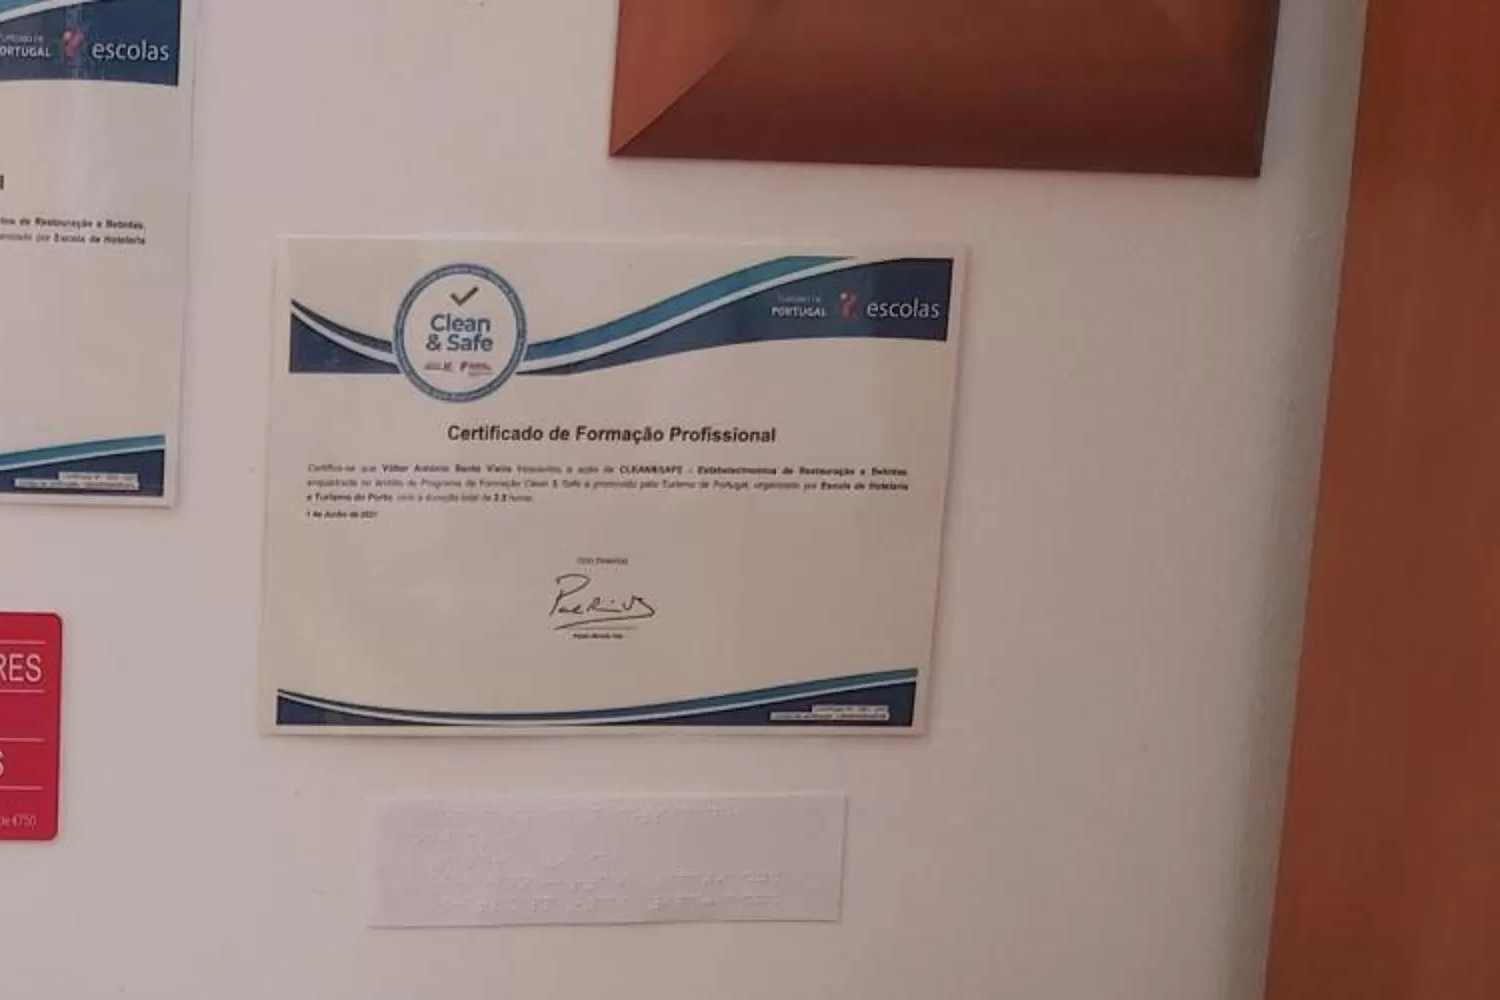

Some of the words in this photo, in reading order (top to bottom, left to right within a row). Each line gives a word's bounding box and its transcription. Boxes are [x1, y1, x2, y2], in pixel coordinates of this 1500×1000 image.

[92, 40, 170, 62] escolas
[771, 306, 827, 318] PORTUGAL
[866, 297, 941, 320] escolas
[430, 313, 491, 333] Clean
[425, 334, 442, 352] &
[447, 333, 494, 352] Safe
[447, 424, 544, 442] Certificado
[549, 424, 570, 442] de
[575, 424, 665, 446] Formação
[670, 425, 776, 446] Profissional
